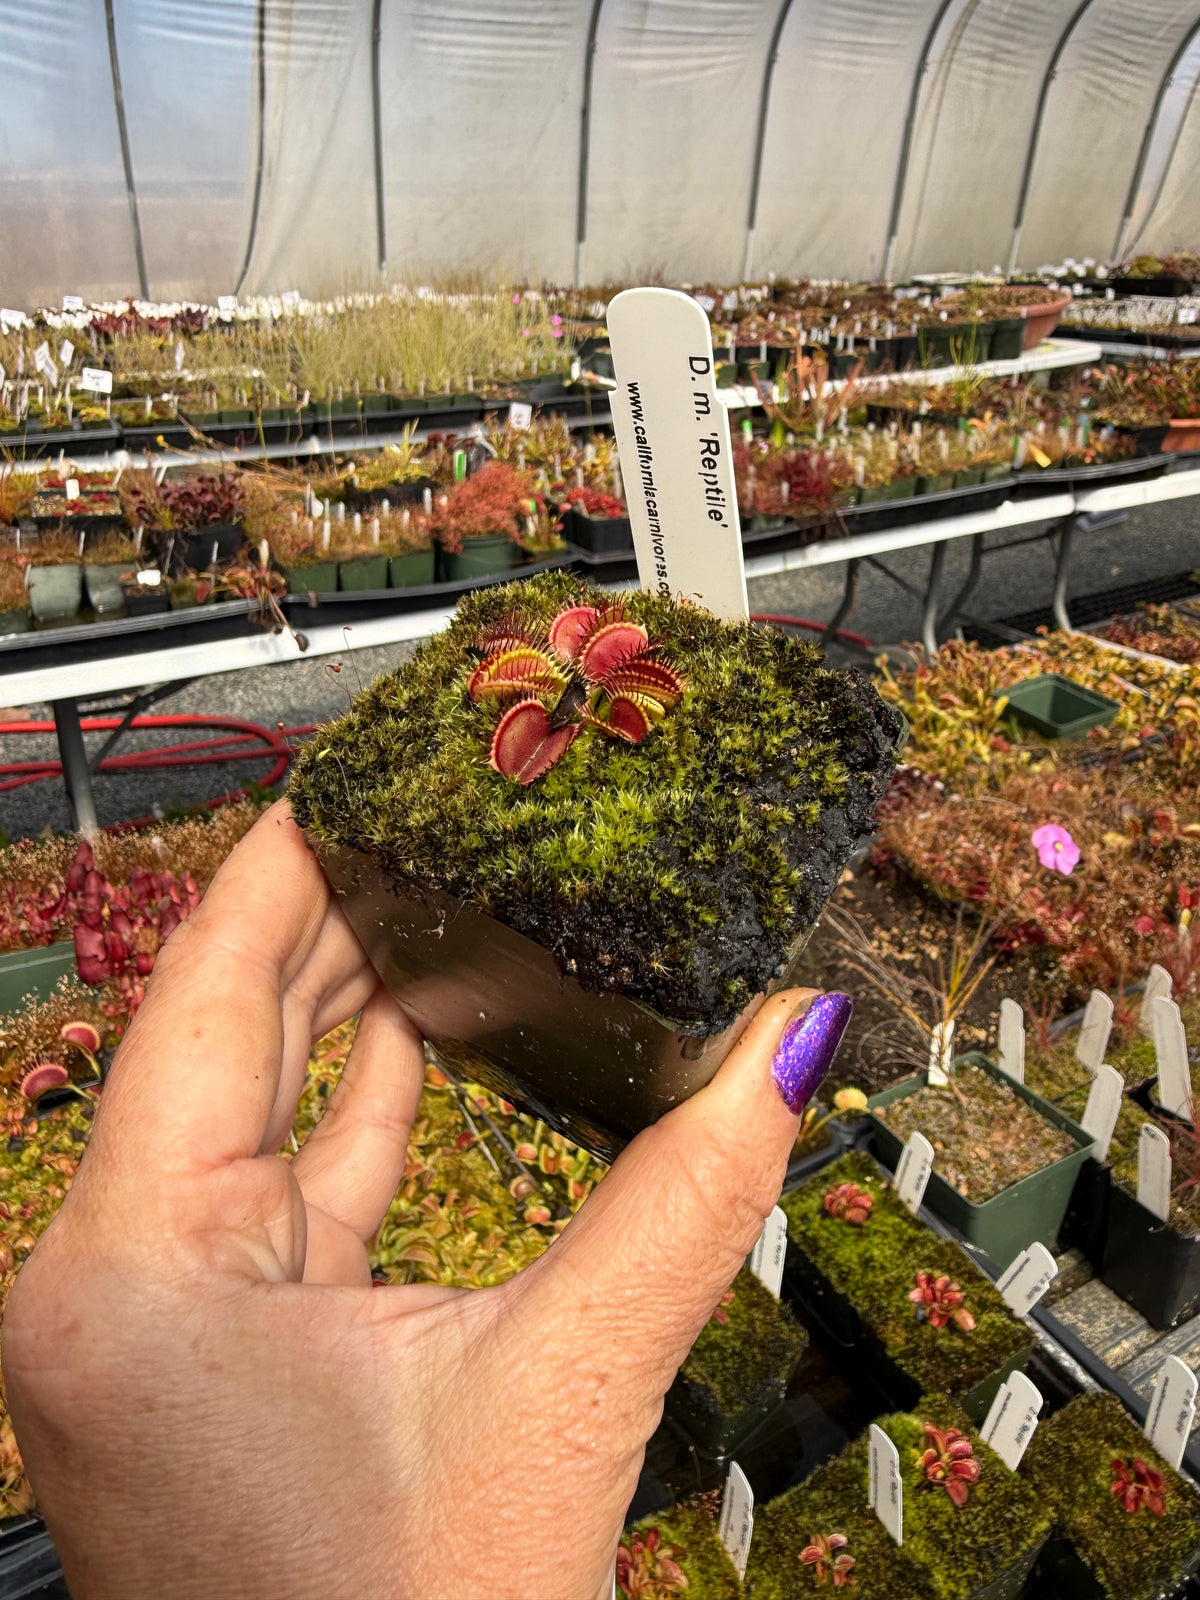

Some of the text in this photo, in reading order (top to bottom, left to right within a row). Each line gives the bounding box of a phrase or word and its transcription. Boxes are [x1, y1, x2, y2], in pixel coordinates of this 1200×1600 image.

[688, 356, 729, 528] D. m. 'Reptile'
